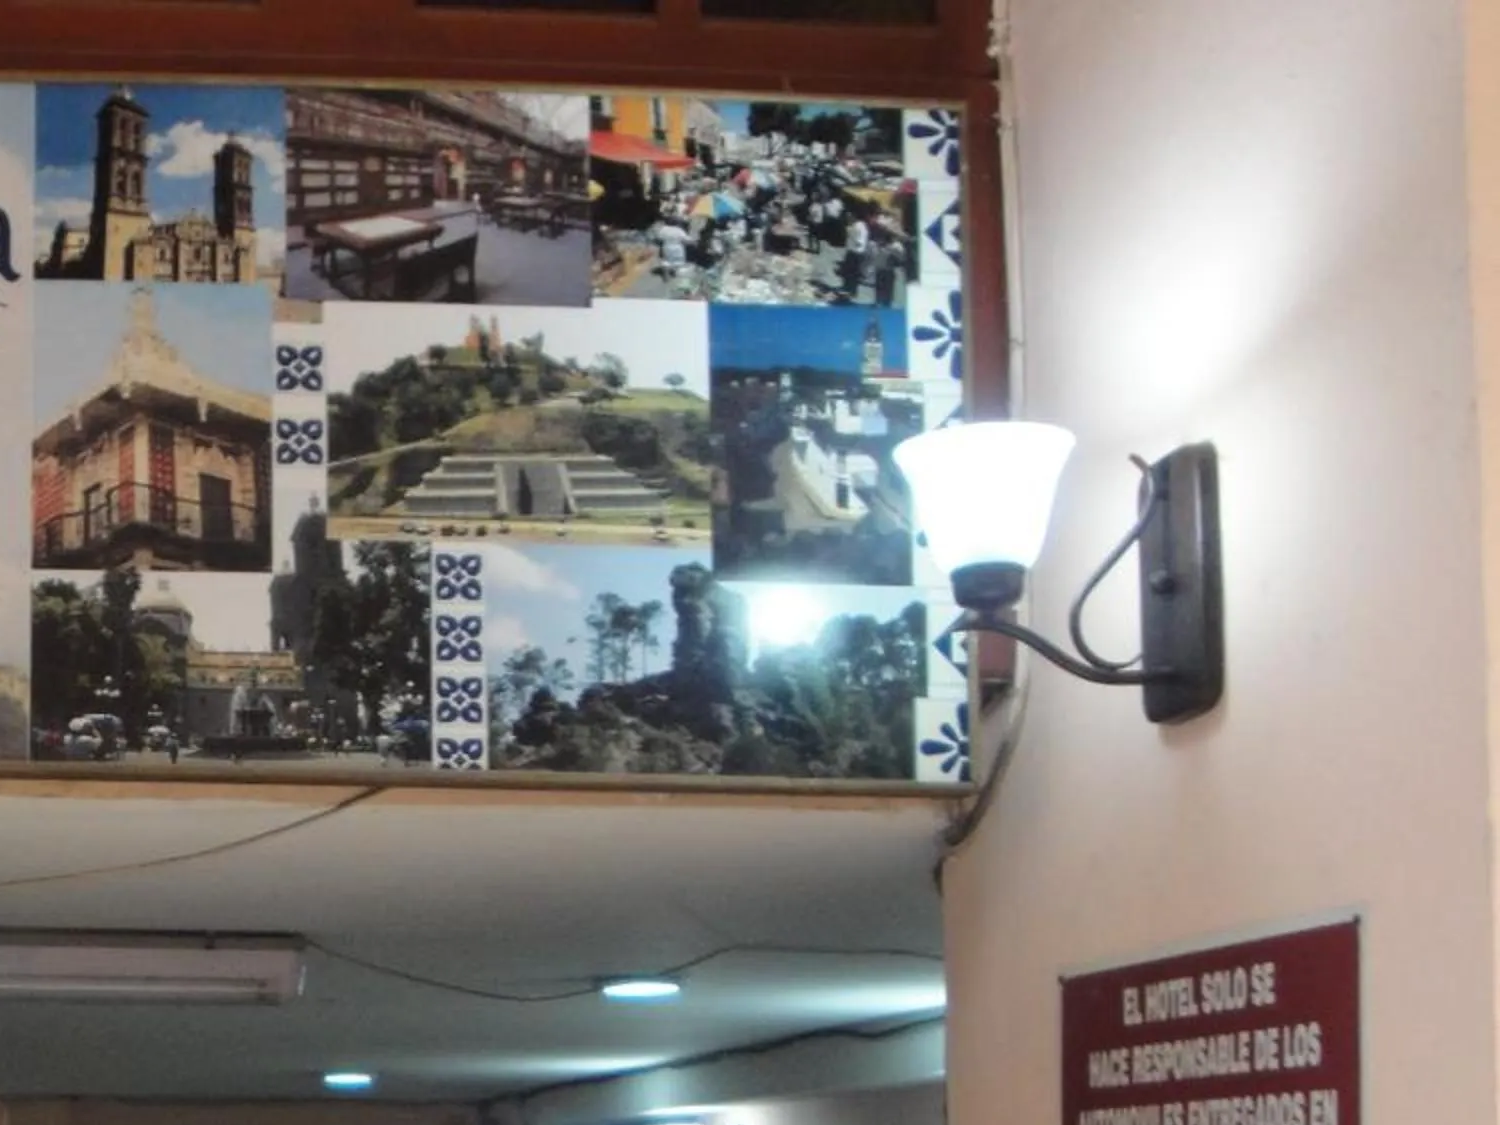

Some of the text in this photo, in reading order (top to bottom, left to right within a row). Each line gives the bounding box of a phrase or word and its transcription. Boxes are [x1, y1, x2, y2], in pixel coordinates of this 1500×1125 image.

[1123, 961, 1276, 1026] EL HOTEL SOLO SE
[1089, 1022, 1322, 1088] HACE RESPONSABLE DE LOS
